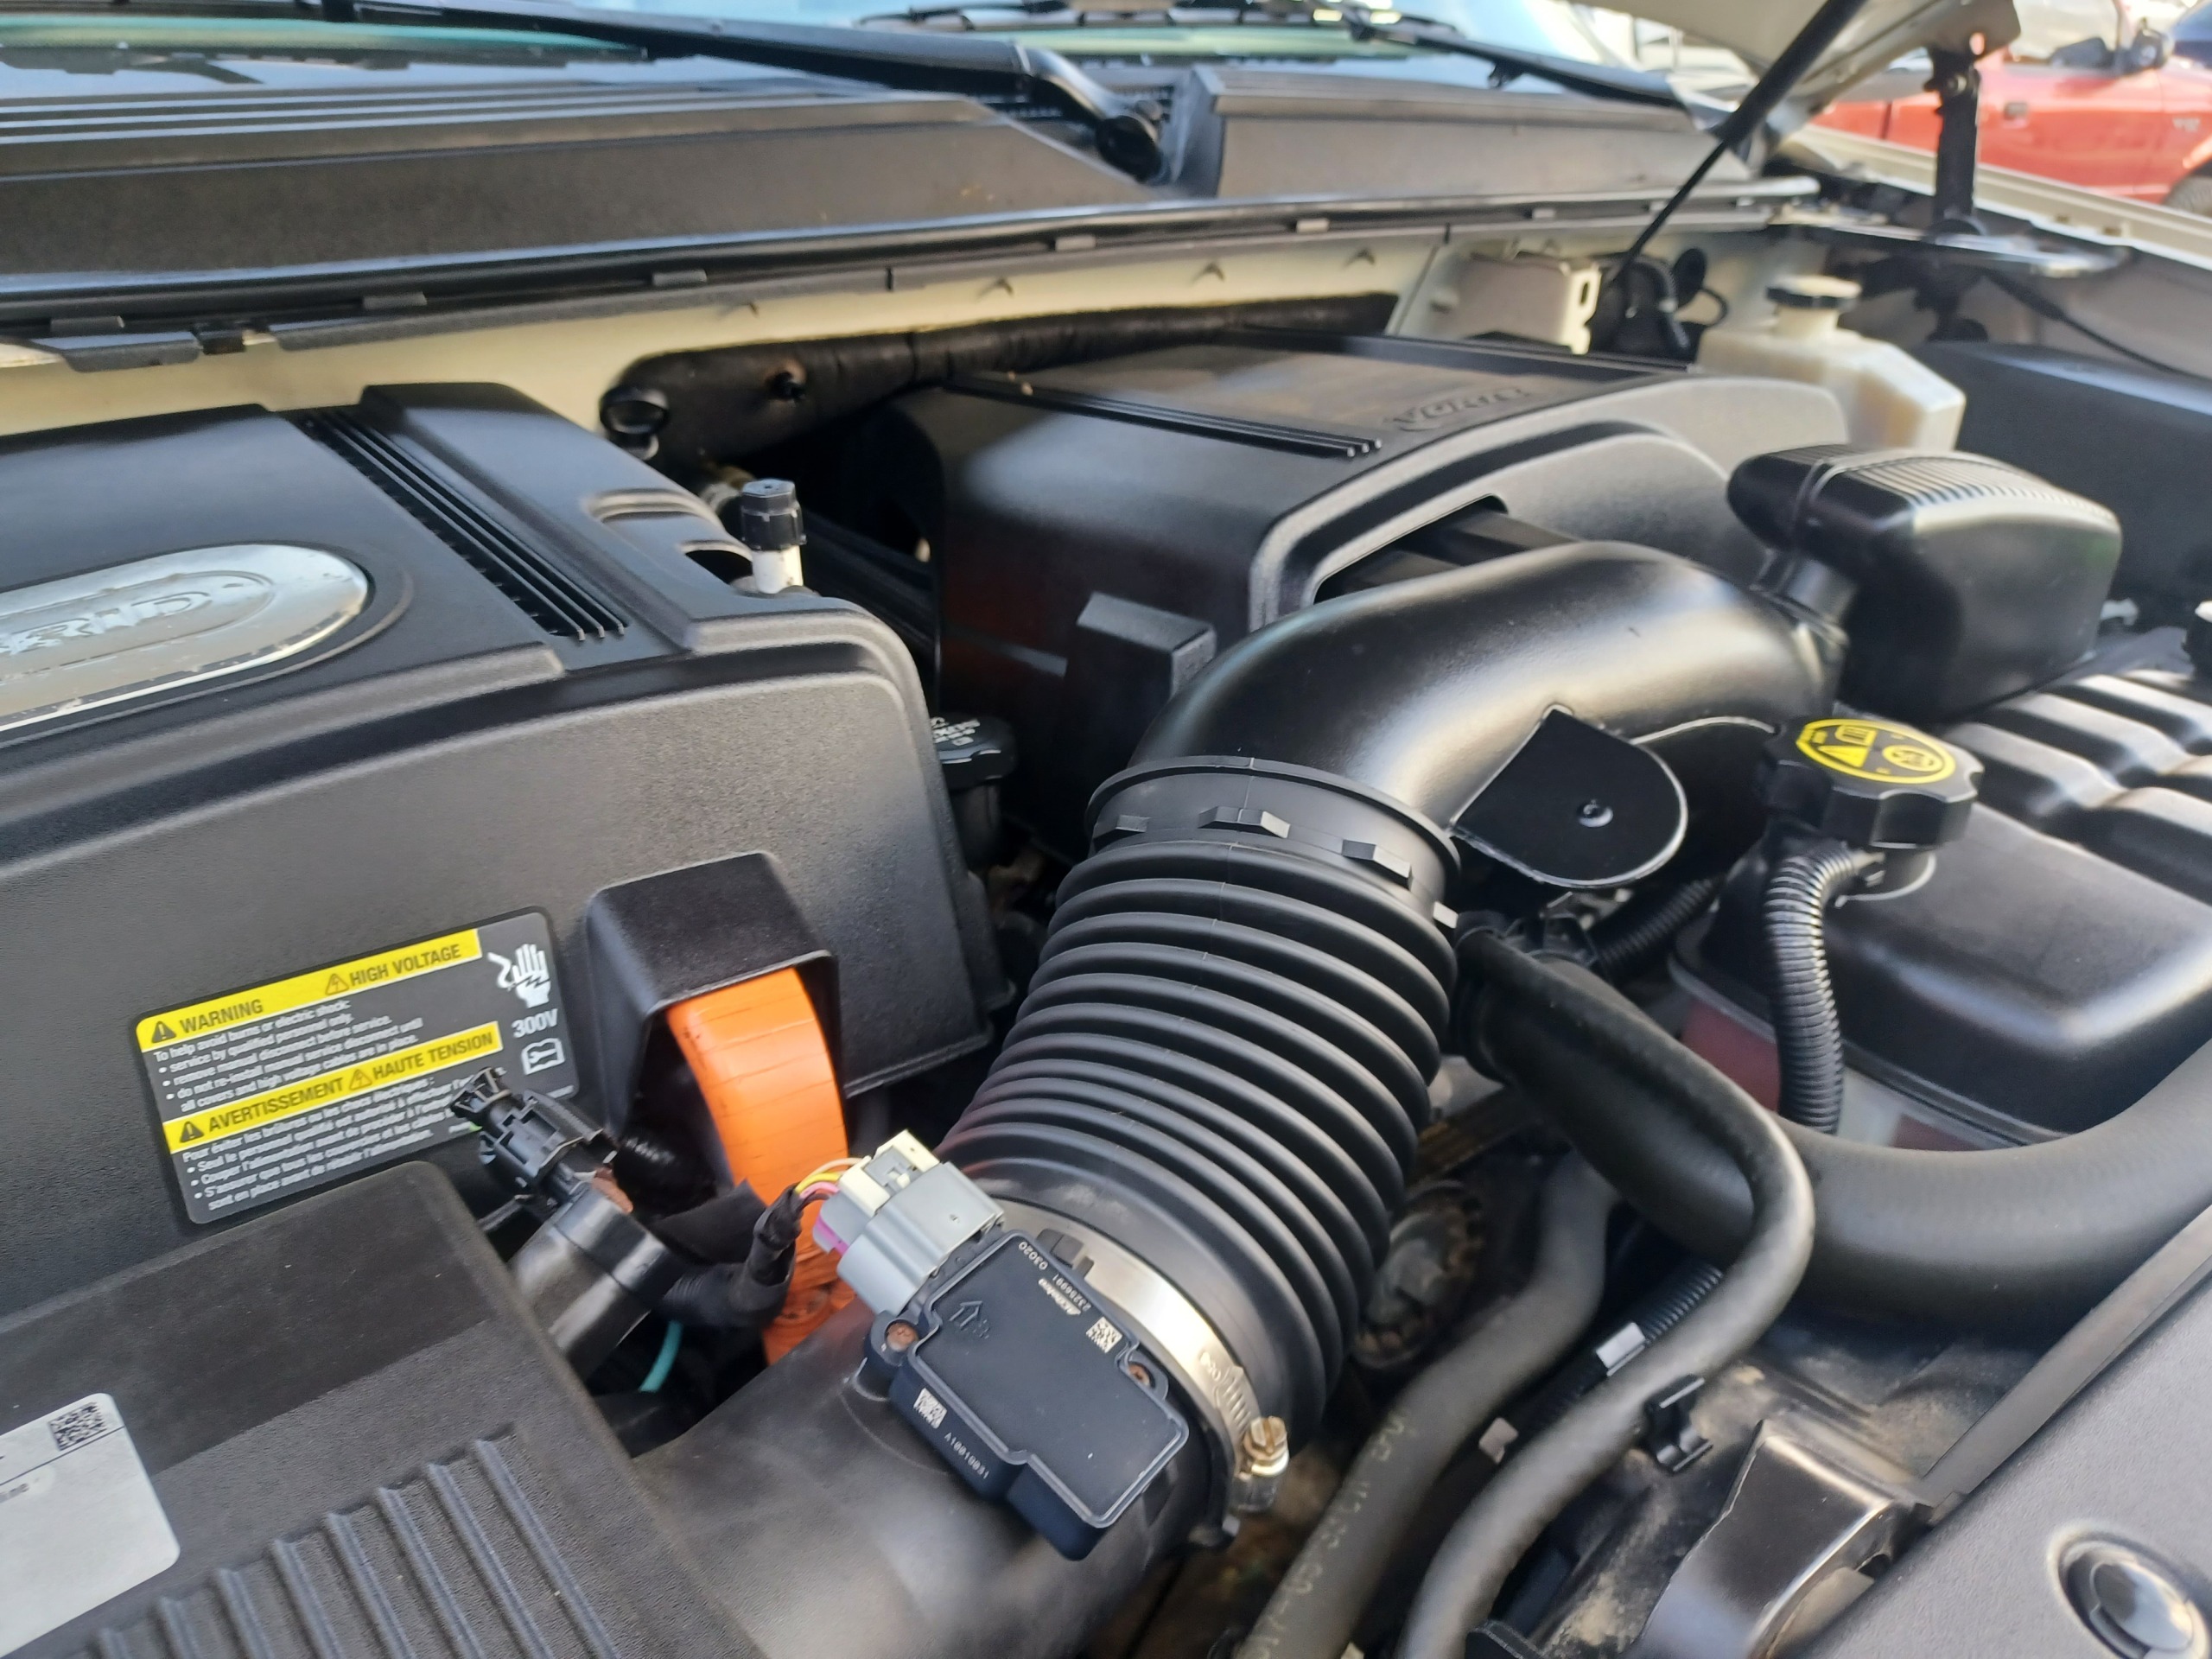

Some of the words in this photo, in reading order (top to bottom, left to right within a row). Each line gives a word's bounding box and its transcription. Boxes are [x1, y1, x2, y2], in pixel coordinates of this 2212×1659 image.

[348, 963, 389, 987] HIGH
[392, 943, 461, 975] VOLTAGE
[179, 998, 263, 1034] WARNING
[511, 1008, 560, 1038] 300V
[153, 1049, 169, 1062] To
[169, 1041, 196, 1059] help
[195, 1033, 227, 1050] avoid
[261, 1021, 275, 1032] or
[168, 1052, 212, 1072] service
[211, 1047, 227, 1062] by
[372, 1052, 424, 1081] HAUTE
[428, 1032, 493, 1064] TENSION
[176, 1085, 193, 1099] do
[193, 1079, 213, 1094] not
[180, 1098, 196, 1112] all
[234, 1080, 257, 1096] and
[256, 1073, 283, 1091] high
[206, 1077, 346, 1133] AVERTISSEMENT
[181, 1145, 210, 1162] Pour
